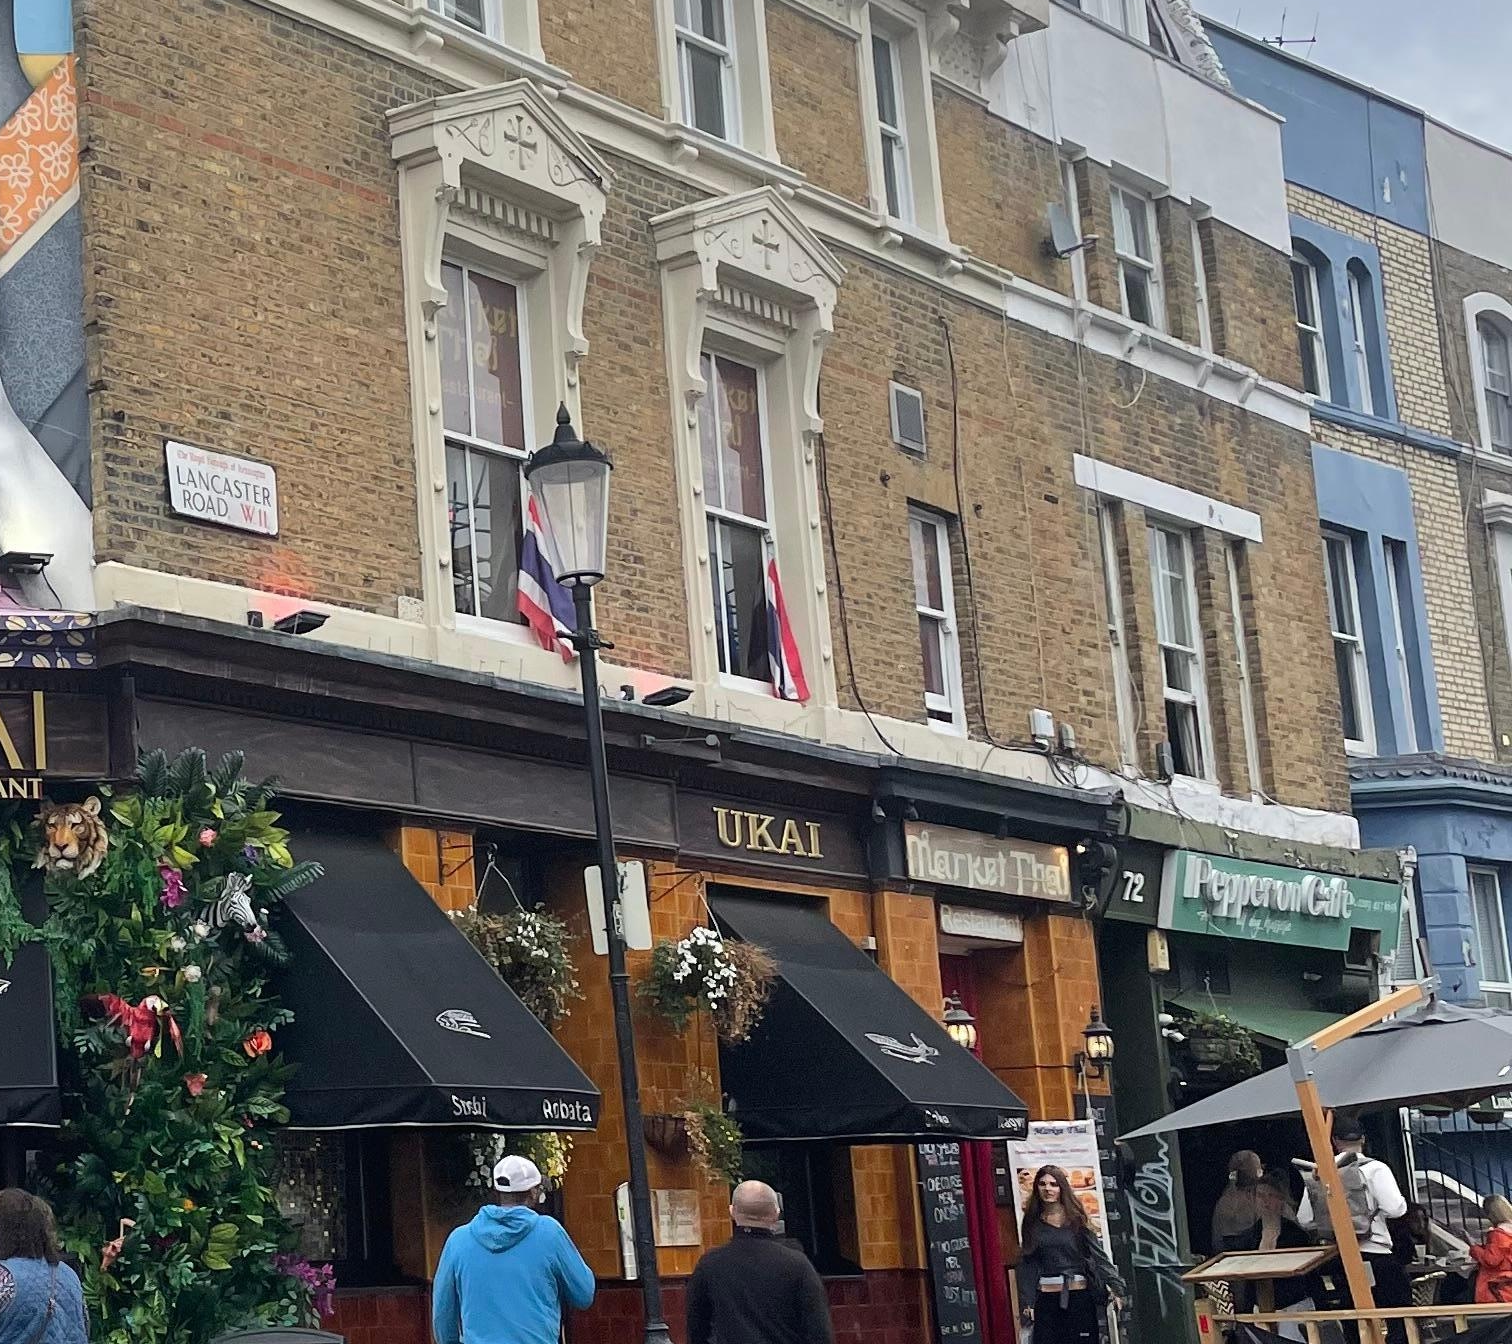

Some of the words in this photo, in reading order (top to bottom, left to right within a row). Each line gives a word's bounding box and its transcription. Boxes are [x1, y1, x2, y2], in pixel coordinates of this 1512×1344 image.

[176, 465, 271, 507] LANCASTER
[183, 489, 228, 517] ROAD
[712, 806, 824, 858] UKAI
[906, 830, 1006, 889] Market
[1009, 850, 1070, 896] Thai
[1122, 870, 1145, 903] 72
[940, 904, 1022, 935] Restaurant
[542, 1098, 592, 1122] Robata
